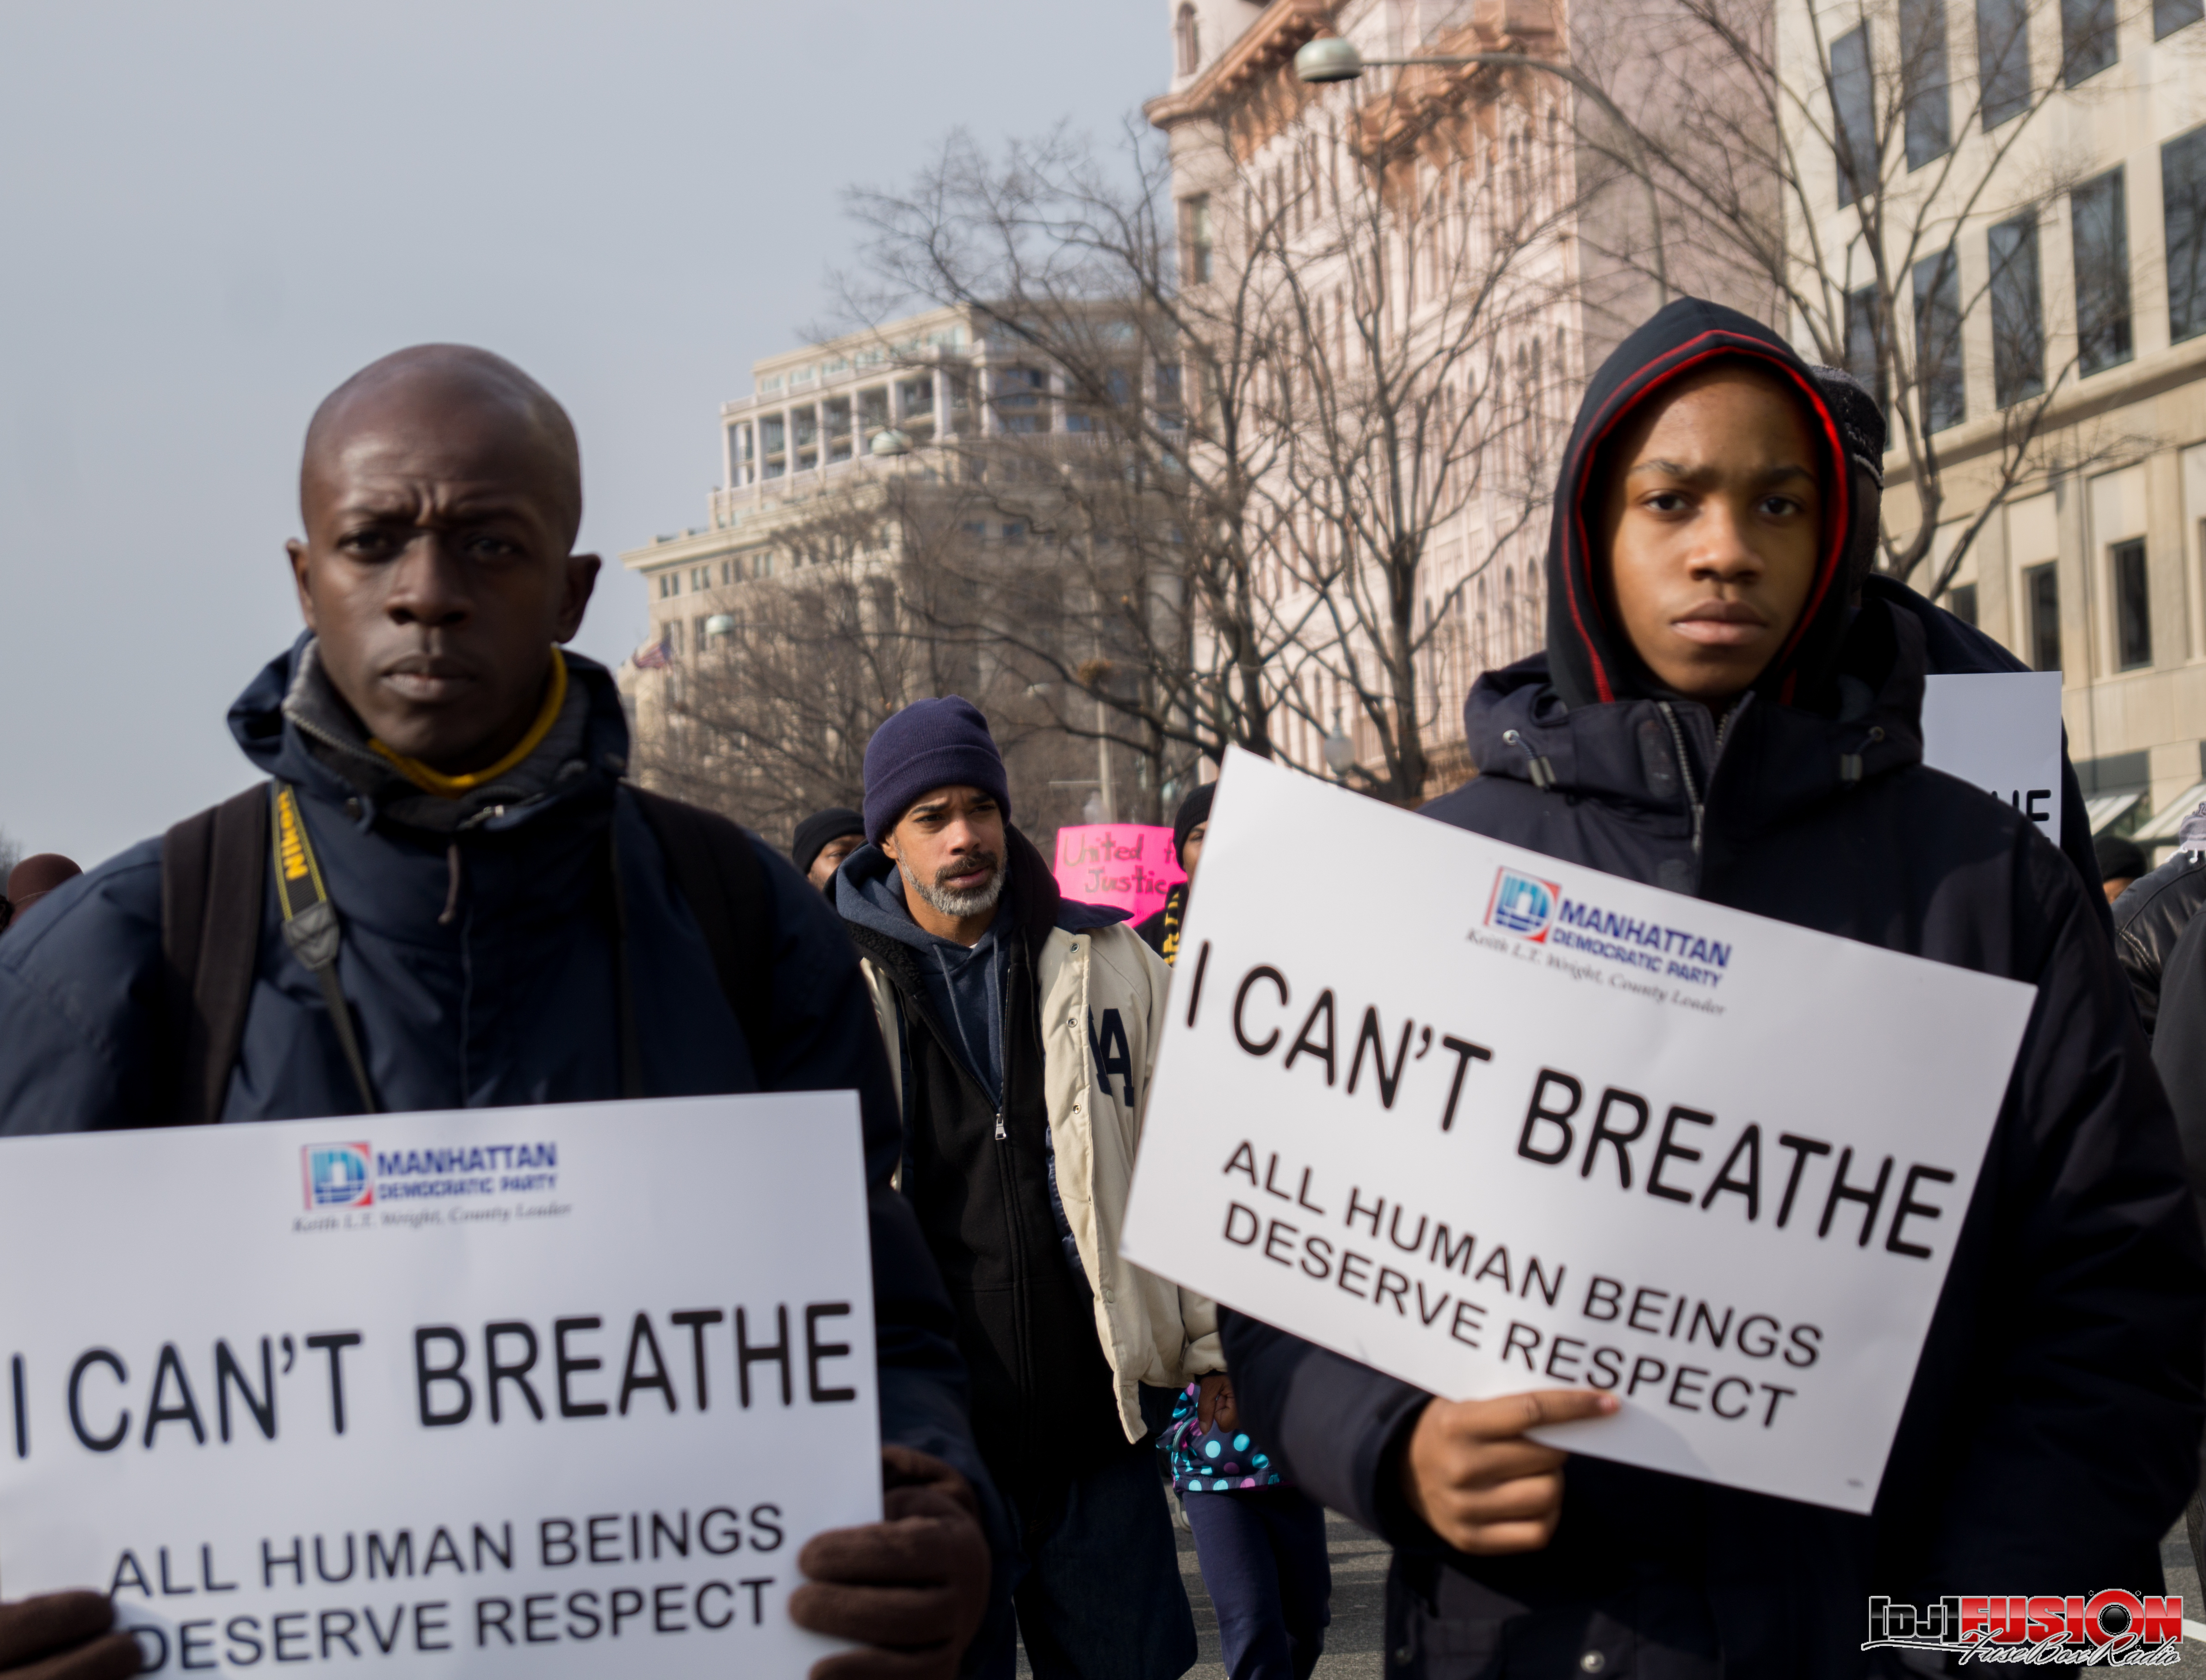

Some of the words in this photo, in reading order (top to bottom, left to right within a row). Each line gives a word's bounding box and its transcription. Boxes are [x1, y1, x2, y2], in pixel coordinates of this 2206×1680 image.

[1063, 832, 1144, 866] United
[1084, 865, 1168, 895] Justic
[1552, 927, 1663, 972] DEMOCRATIC
[1667, 958, 1722, 988] PARTY
[1559, 898, 1732, 968] MANHATTAN
[1185, 939, 1212, 1030] I
[1232, 964, 1493, 1132] CAN'T
[1517, 1068, 1956, 1261] BREATHE
[377, 1142, 556, 1177] MANHATTAN
[377, 1178, 494, 1200] DEMOCRATIC
[500, 1172, 556, 1192] PARTY
[1223, 1140, 1325, 1216] ALL
[1345, 1186, 1566, 1308] HUMAN
[1582, 1276, 1823, 1369] BEINGS
[1223, 1201, 1487, 1348] DESERVE
[1502, 1322, 1797, 1429] RESPECT
[11, 1353, 28, 1459] I
[66, 1331, 363, 1453] CAN'T
[414, 1301, 857, 1428] BREATHE
[109, 1543, 238, 1600] ALL
[261, 1521, 514, 1588] HUMAN
[539, 1503, 785, 1568] BEINGS
[126, 1597, 453, 1674] DESERVE
[475, 1576, 776, 1648] RESPECT
